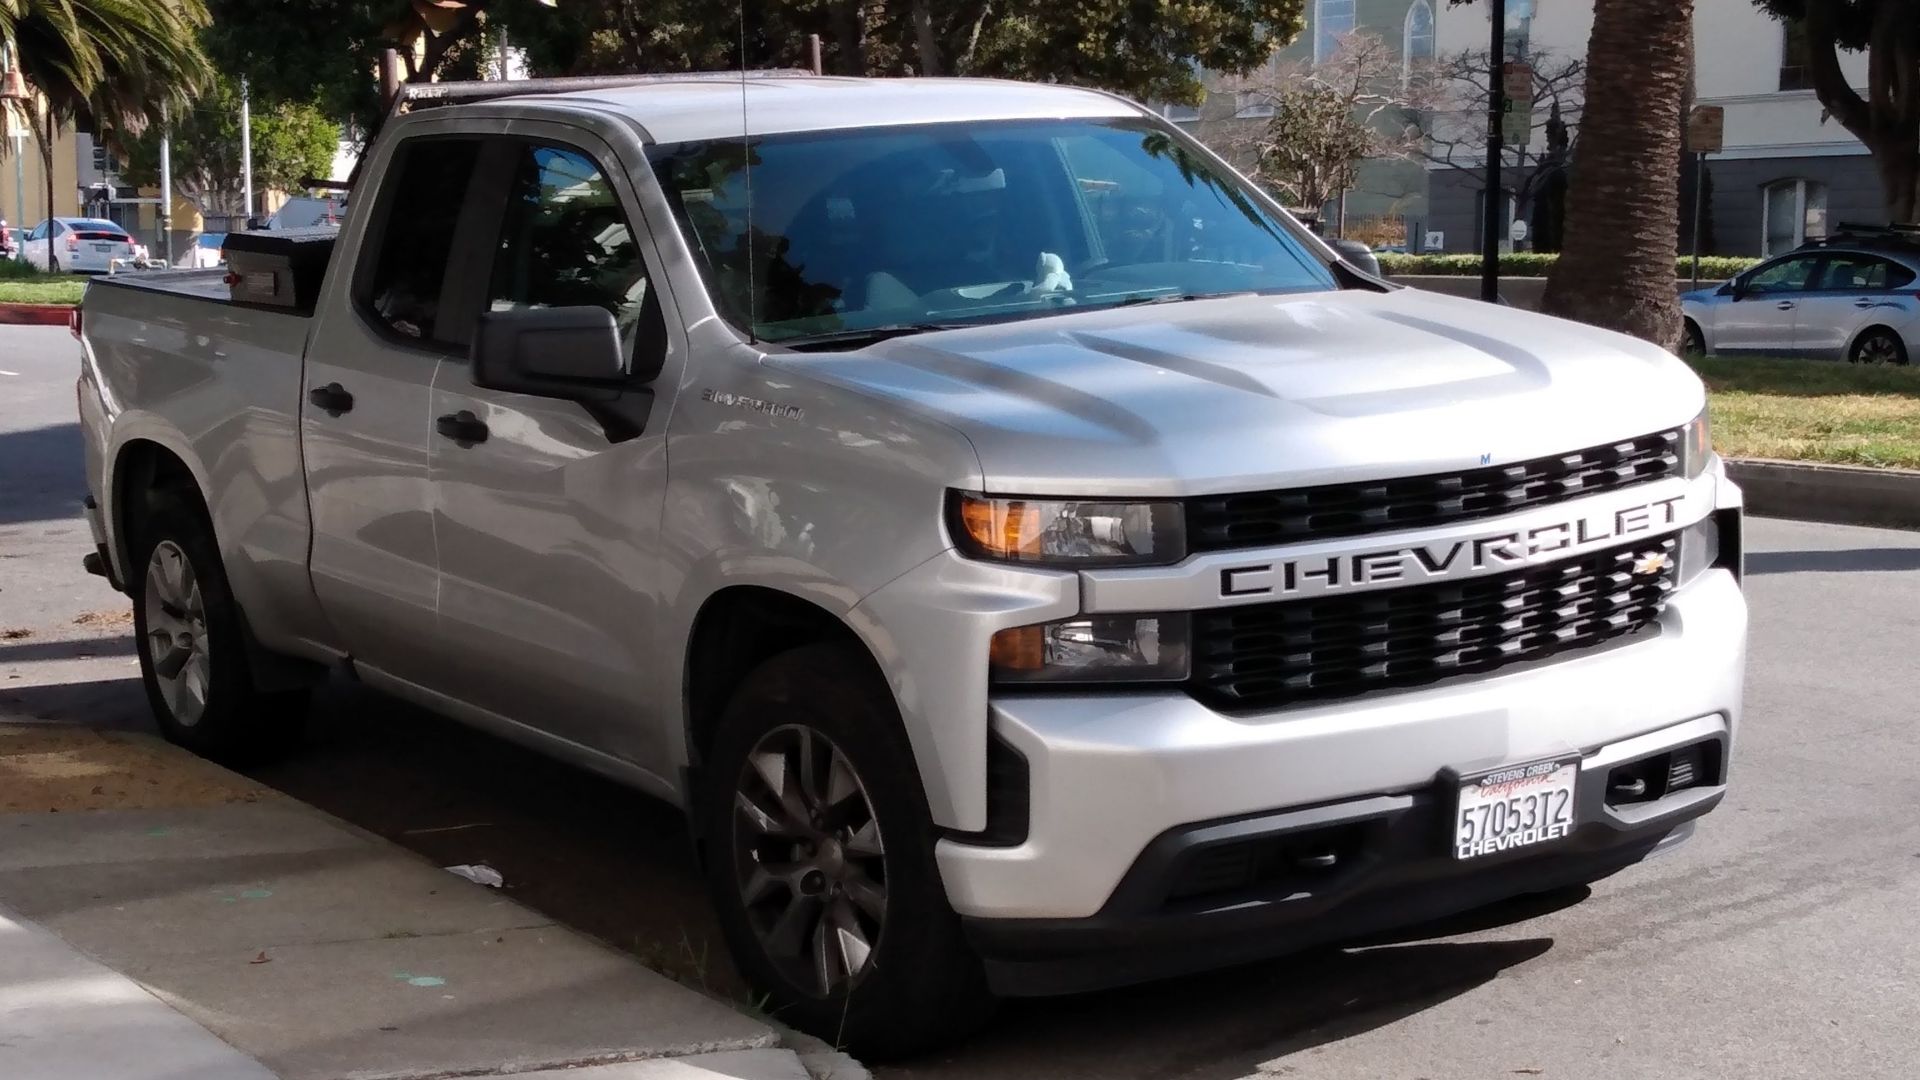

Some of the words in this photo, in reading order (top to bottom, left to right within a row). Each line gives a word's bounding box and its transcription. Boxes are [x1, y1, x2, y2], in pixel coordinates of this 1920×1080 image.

[1219, 494, 1685, 599] CHEVROLET
[1487, 768, 1525, 785] STEVENS
[1526, 762, 1555, 777] CREEK
[1462, 788, 1569, 843] 57053T2
[1458, 823, 1571, 859] CHEVROLET
